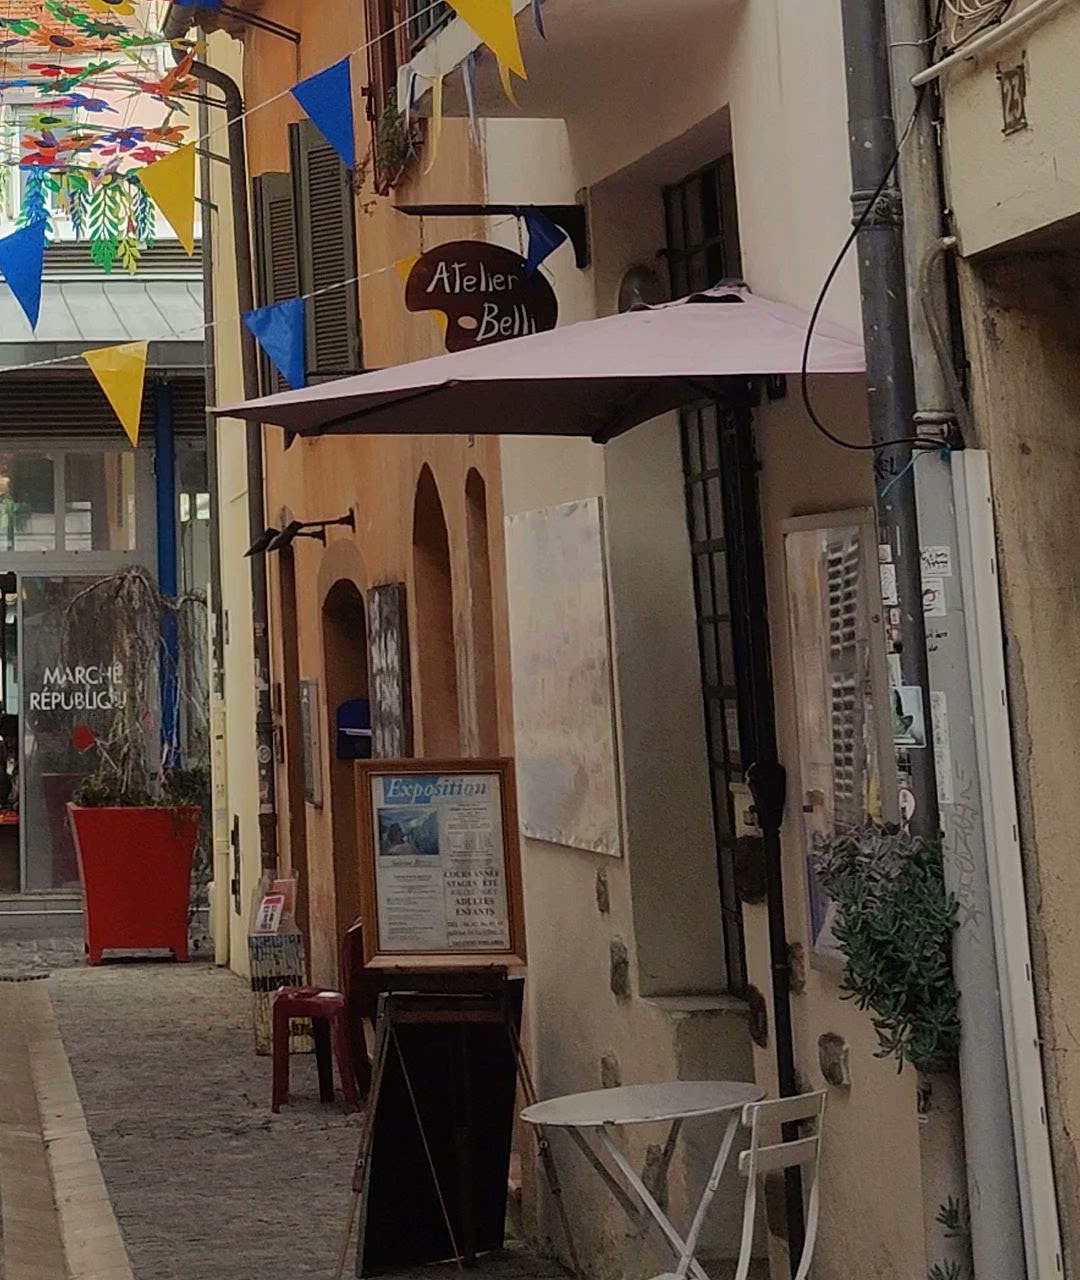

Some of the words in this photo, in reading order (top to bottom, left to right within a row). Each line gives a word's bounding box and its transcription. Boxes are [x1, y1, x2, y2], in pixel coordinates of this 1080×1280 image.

[476, 302, 536, 341] Belli
[29, 686, 128, 710] RÉPUBLIQU
[387, 778, 487, 803] Exposition
